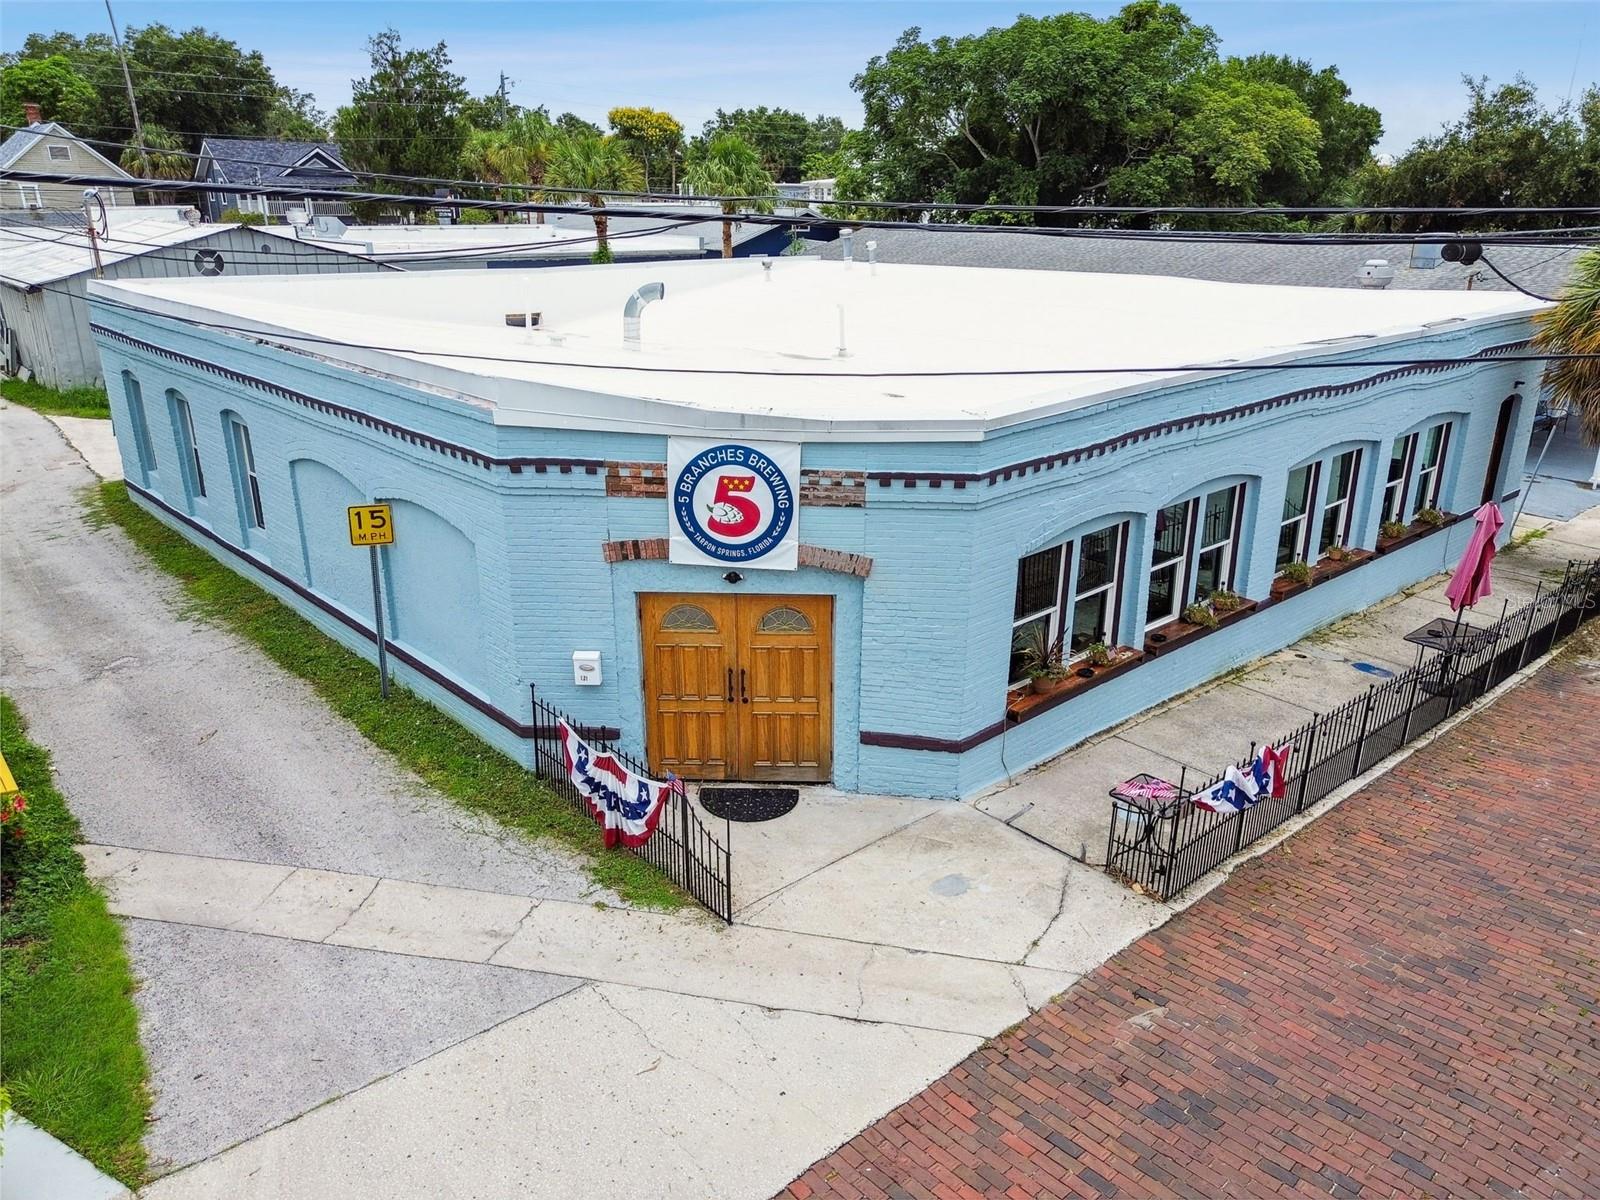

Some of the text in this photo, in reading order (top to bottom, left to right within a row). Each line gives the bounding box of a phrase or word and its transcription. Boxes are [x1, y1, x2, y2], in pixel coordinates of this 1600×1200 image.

[678, 448, 790, 509] 5 BRANCHES BREWING
[707, 475, 761, 538] 5
[354, 510, 386, 530] 15
[358, 532, 386, 541] MPH
[693, 533, 716, 552] TARPON
[748, 536, 774, 555] FLORIDA
